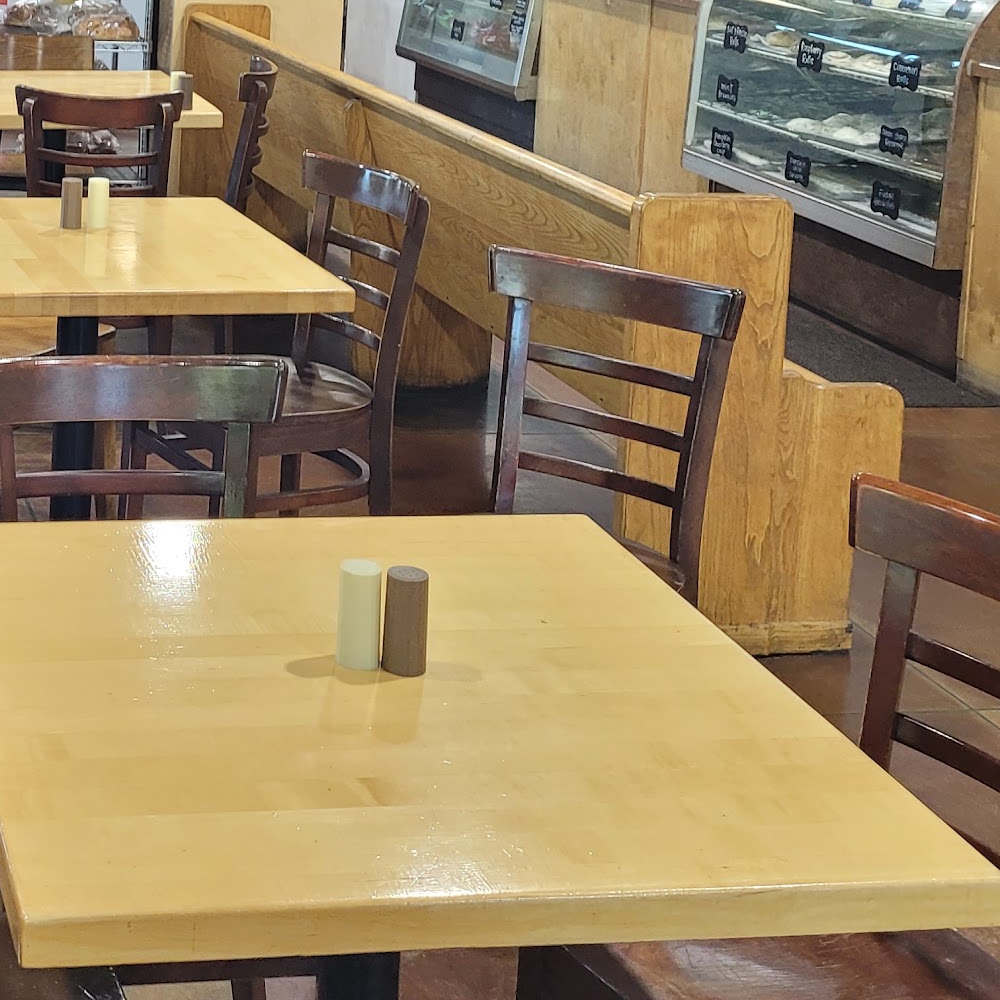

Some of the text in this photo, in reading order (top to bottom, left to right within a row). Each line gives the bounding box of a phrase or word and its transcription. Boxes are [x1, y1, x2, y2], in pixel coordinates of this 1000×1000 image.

[801, 41, 822, 60] Raspberry
[801, 54, 815, 65] Rolls
[893, 61, 918, 76] Cinnamon
[896, 74, 910, 85] Rolls
